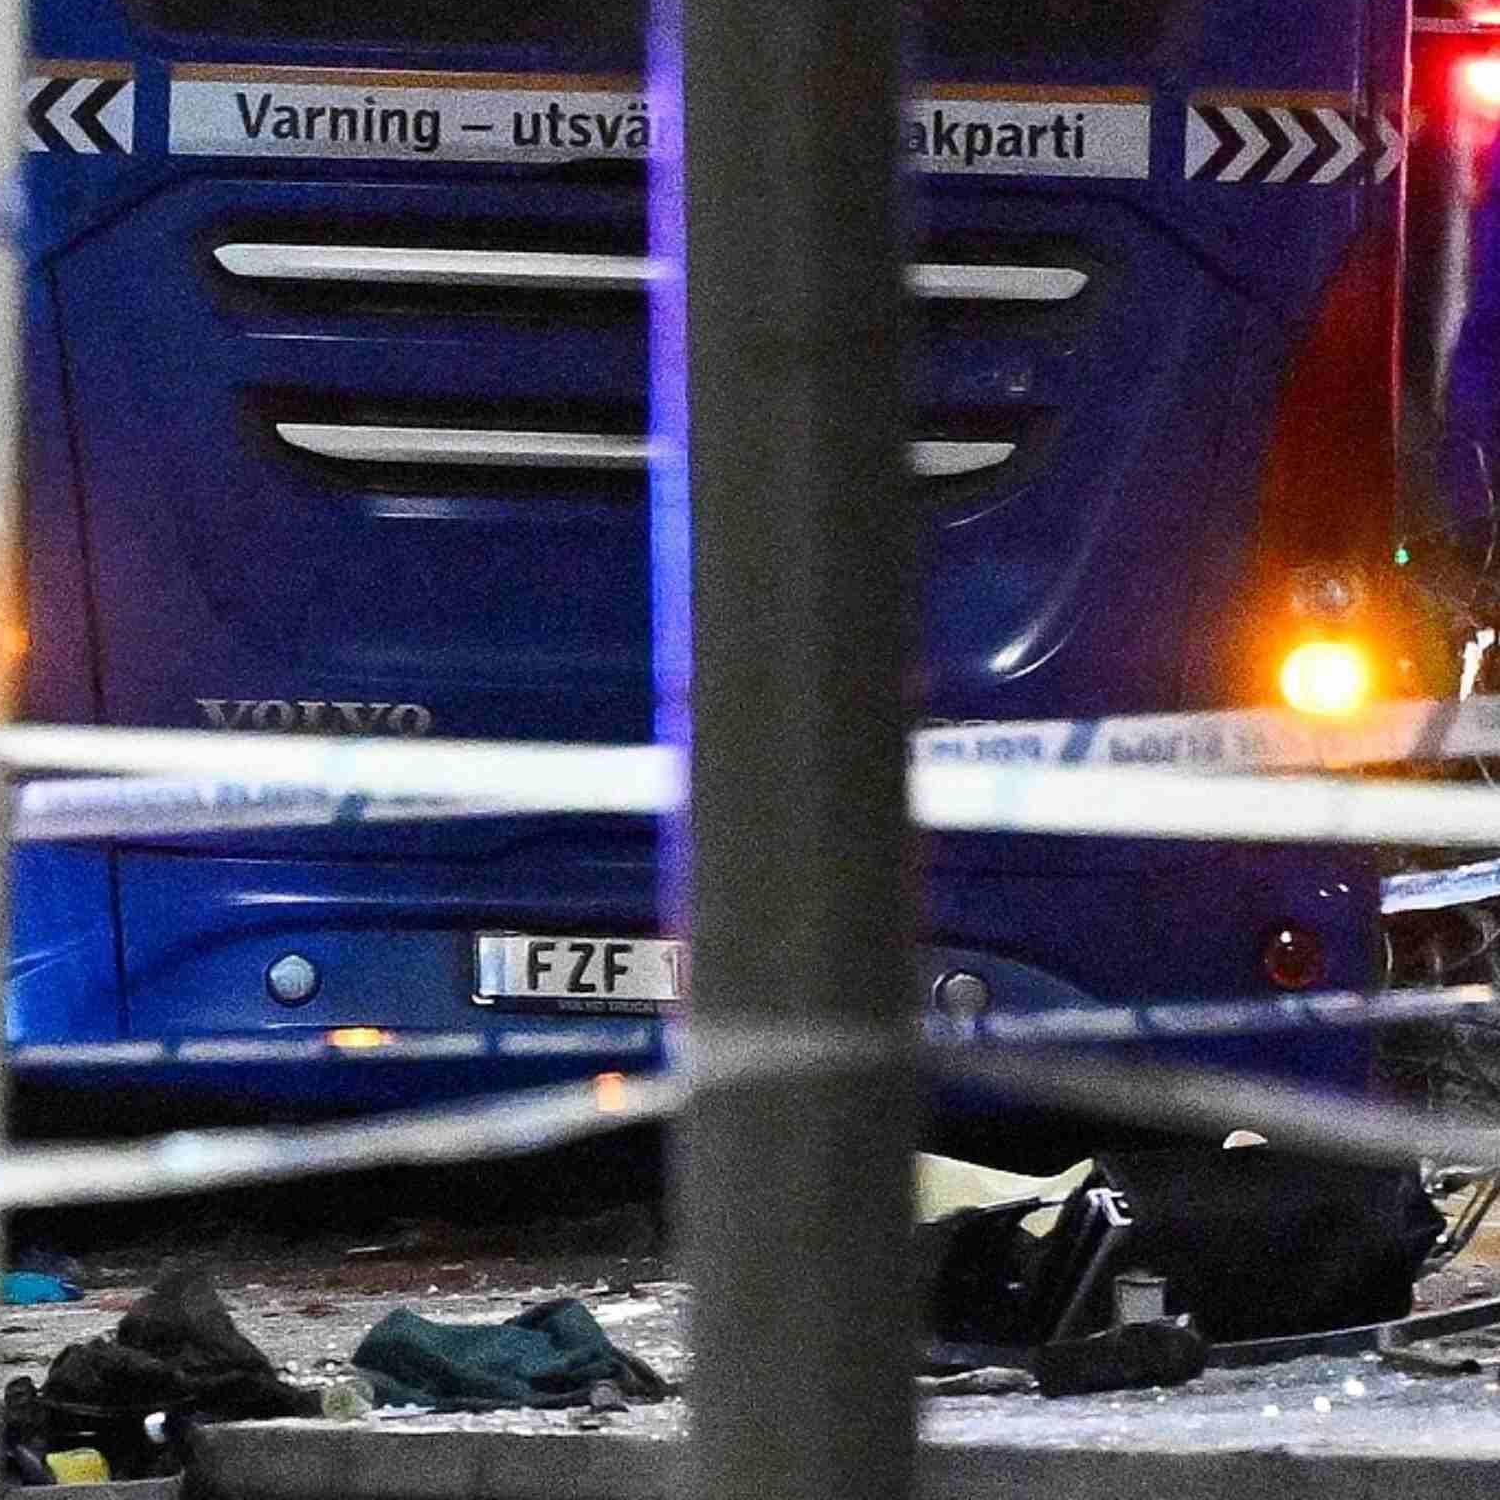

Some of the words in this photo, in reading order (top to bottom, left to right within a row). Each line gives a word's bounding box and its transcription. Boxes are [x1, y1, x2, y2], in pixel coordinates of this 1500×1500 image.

[234, 91, 442, 153] Varning
[513, 102, 650, 148] utsvä
[907, 109, 1085, 167] akparti
[195, 698, 432, 735] VOLVO
[526, 941, 634, 993] FZF
